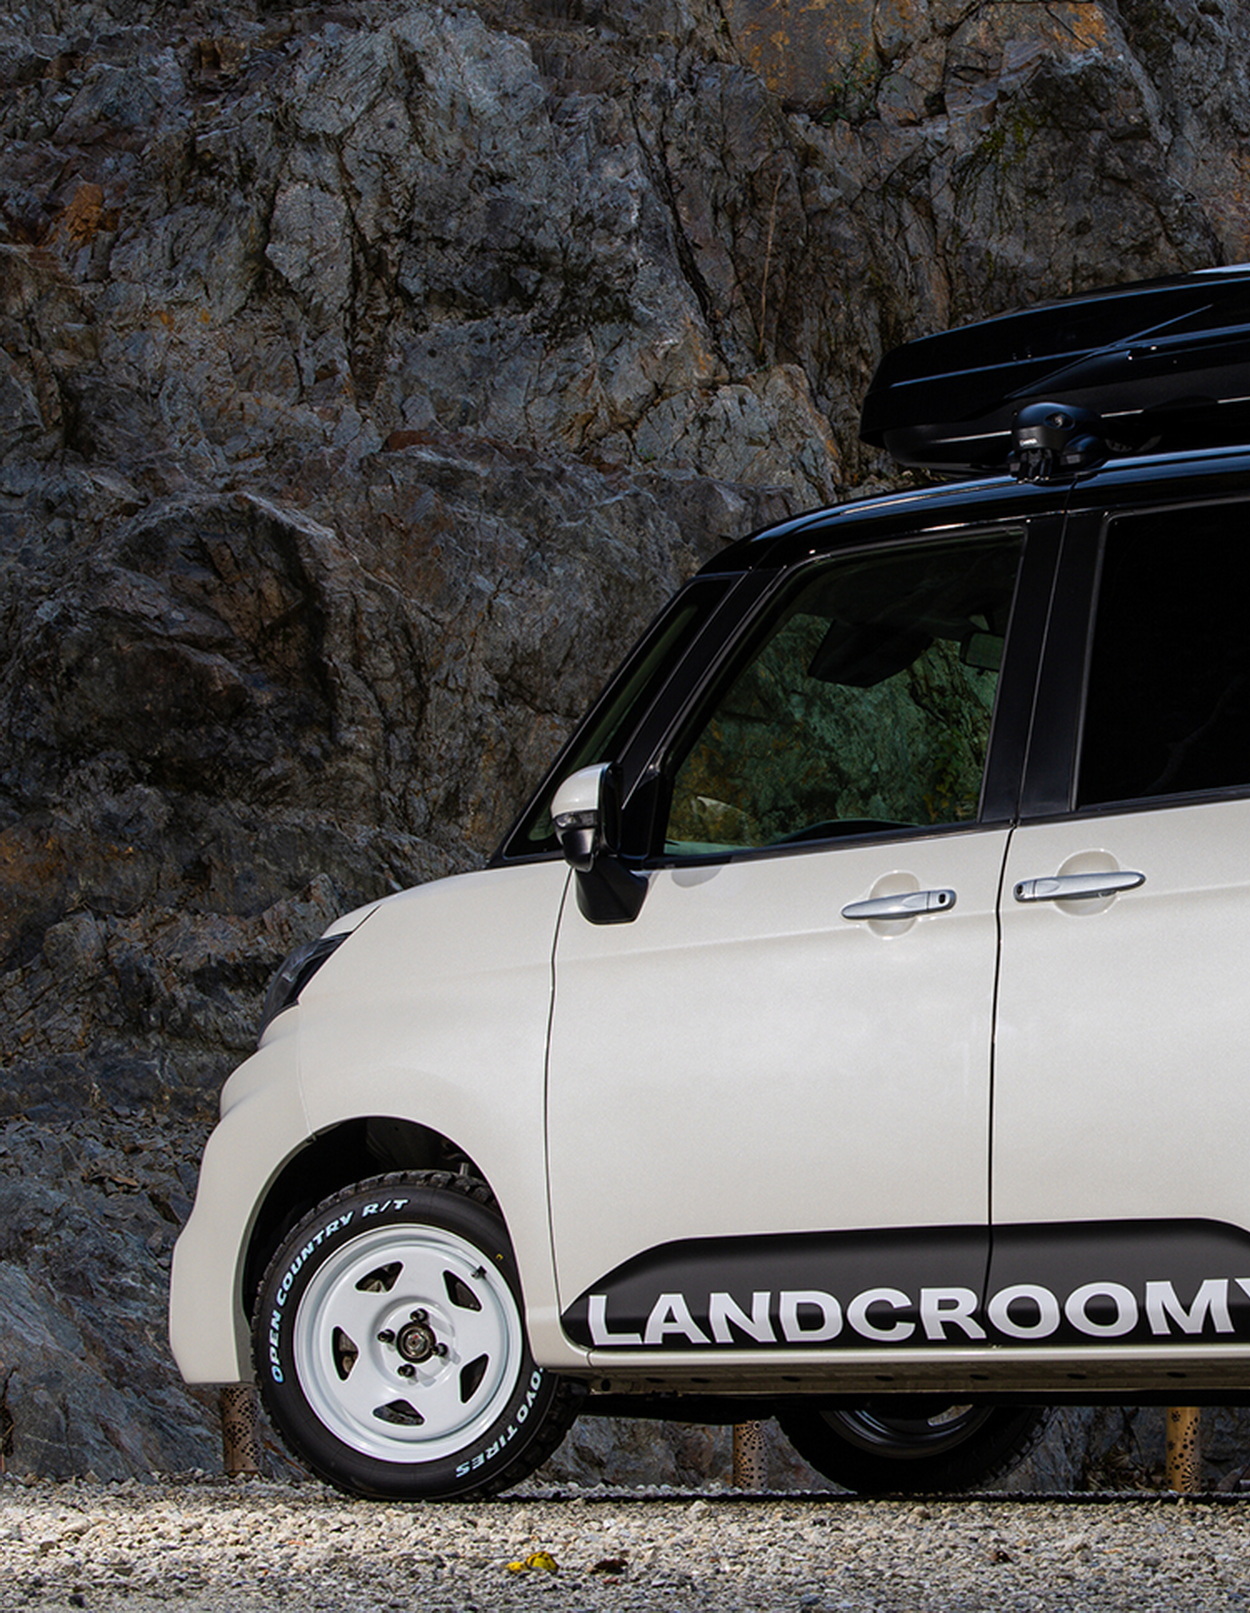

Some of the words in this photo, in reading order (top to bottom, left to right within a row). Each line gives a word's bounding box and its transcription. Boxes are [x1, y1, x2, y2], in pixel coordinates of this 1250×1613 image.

[362, 1198, 410, 1217] R/T
[276, 1210, 355, 1307] COUNTRY
[270, 1309, 286, 1384] OPEN
[516, 1368, 545, 1425] OYO
[455, 1424, 520, 1479] TIRES
